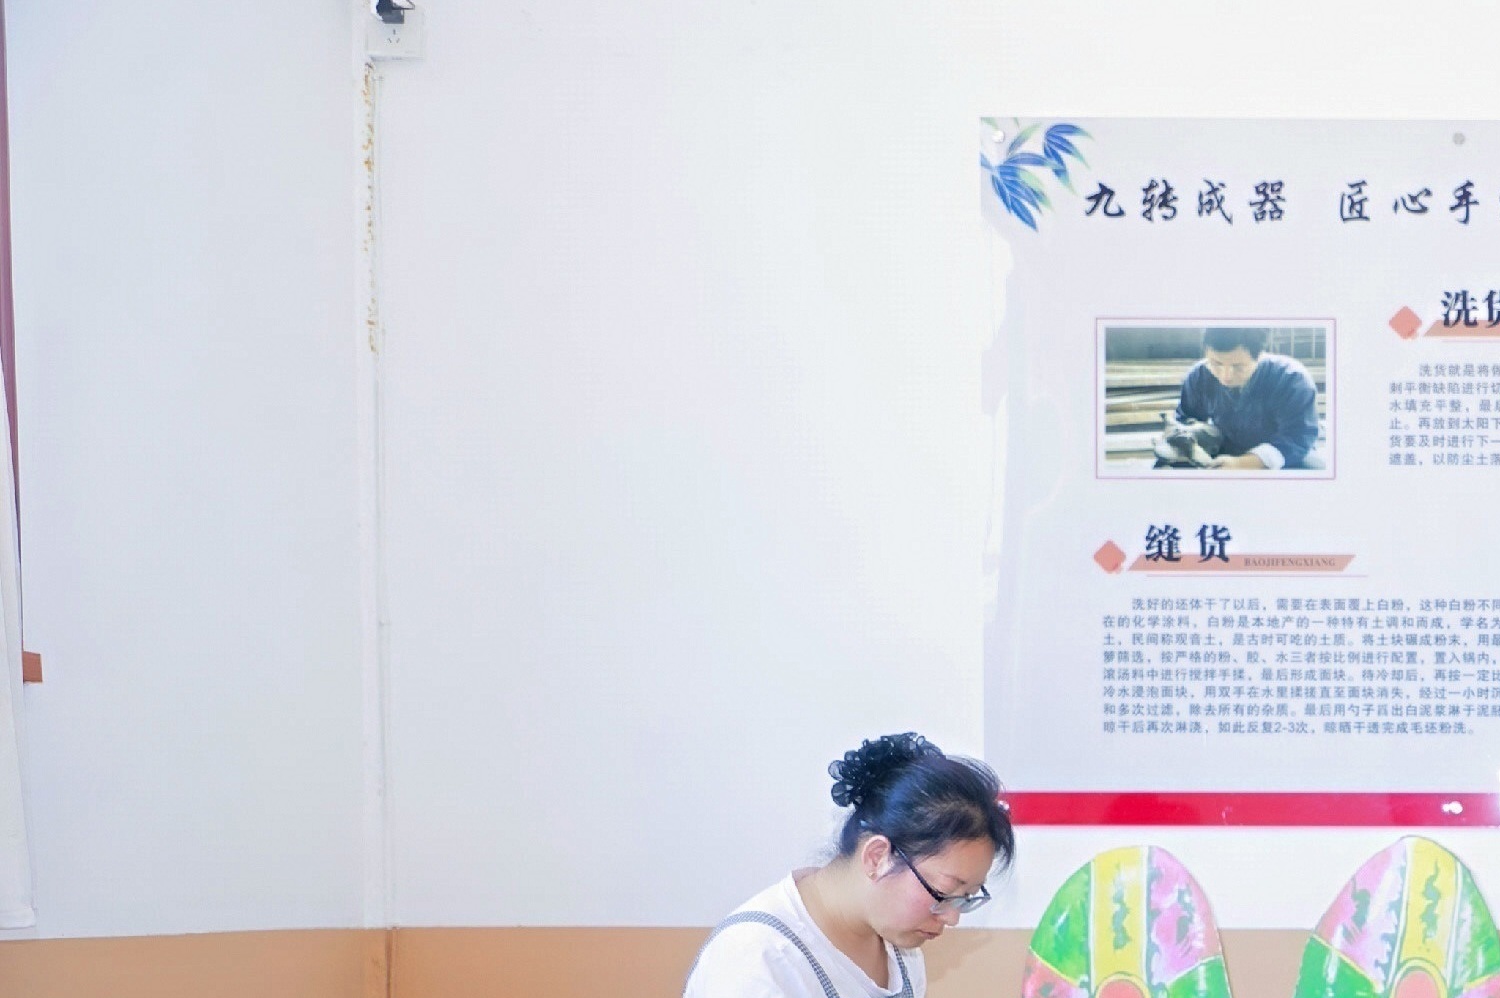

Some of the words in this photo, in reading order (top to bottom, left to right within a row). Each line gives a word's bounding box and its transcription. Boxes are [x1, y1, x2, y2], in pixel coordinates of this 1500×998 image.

[1084, 179, 1287, 223] 九转成器
[1145, 523, 1233, 563] 缝货
